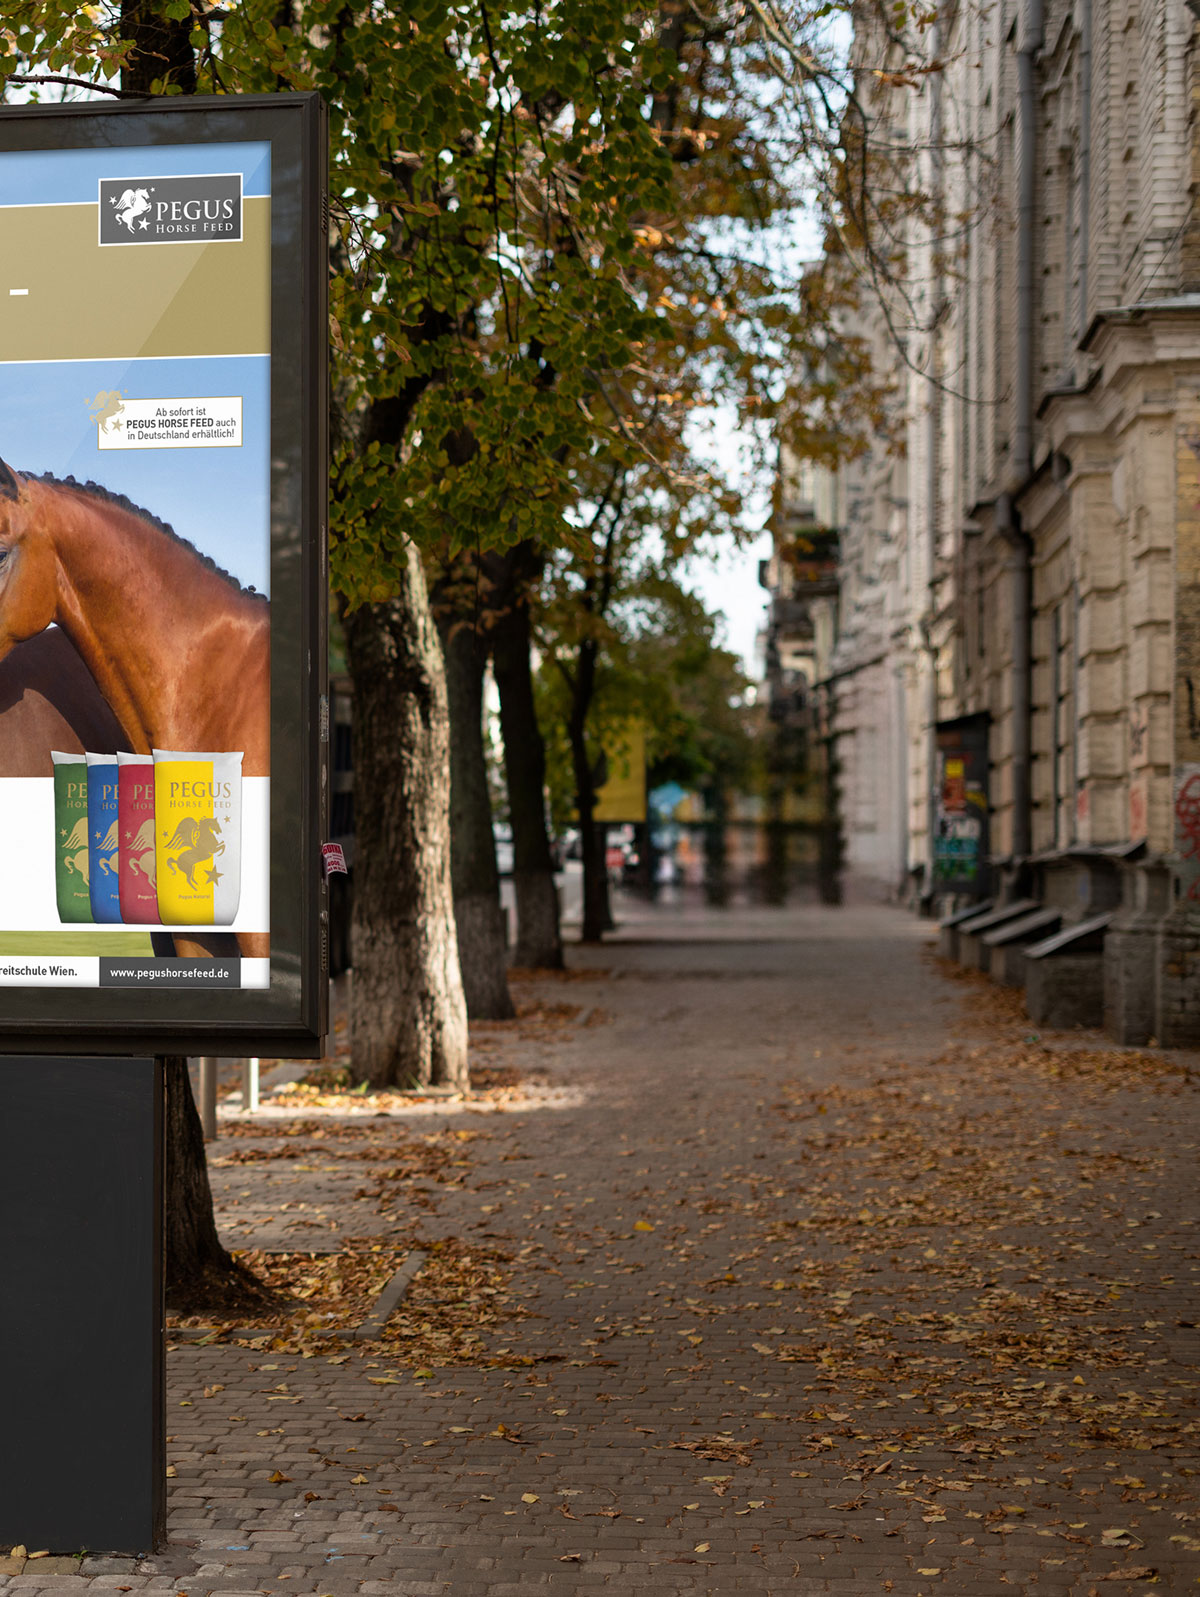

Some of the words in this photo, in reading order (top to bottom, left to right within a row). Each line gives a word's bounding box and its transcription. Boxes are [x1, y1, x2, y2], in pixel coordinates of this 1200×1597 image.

[156, 199, 233, 221] PEGUS
[156, 224, 197, 233] HORSE
[204, 223, 233, 231] FEED
[156, 408, 167, 416] Ab
[169, 407, 193, 416] sofort
[196, 407, 206, 415] ist
[126, 420, 156, 429] PEGUS
[158, 419, 188, 428] HORSE
[191, 418, 213, 427] FEED
[216, 418, 236, 426] auch
[128, 432, 135, 440] in
[138, 430, 189, 439] Deutschland
[192, 429, 234, 438] erhältlich!
[170, 782, 231, 798] PEGUS
[49, 966, 77, 976] Wien.
[110, 968, 229, 979] www.pegushorsefeed.de
